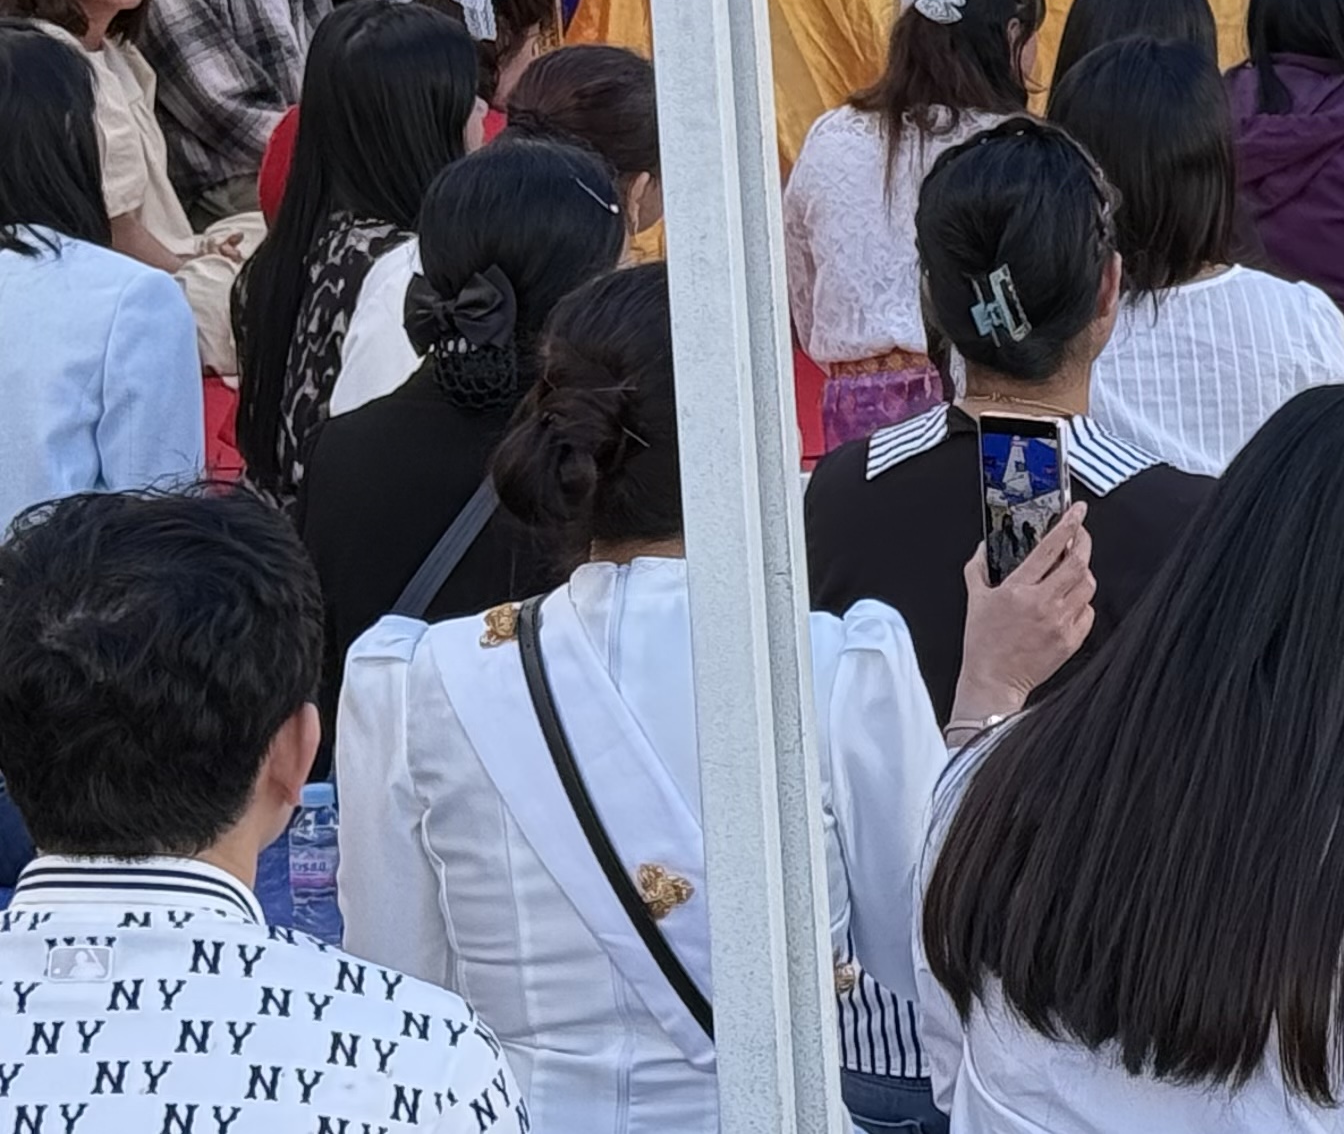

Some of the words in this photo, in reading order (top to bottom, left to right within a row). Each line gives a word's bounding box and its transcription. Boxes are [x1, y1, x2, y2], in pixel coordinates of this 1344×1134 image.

[189, 936, 267, 978] NY
[106, 978, 187, 1011] NY
[334, 959, 403, 1001] NY
[257, 986, 334, 1021] NY
[26, 1021, 106, 1055] NY
[174, 1020, 257, 1055] NY
[400, 1010, 468, 1047] NY
[326, 1031, 399, 1073] NY
[91, 1060, 173, 1095] NY
[244, 1065, 324, 1104] NY
